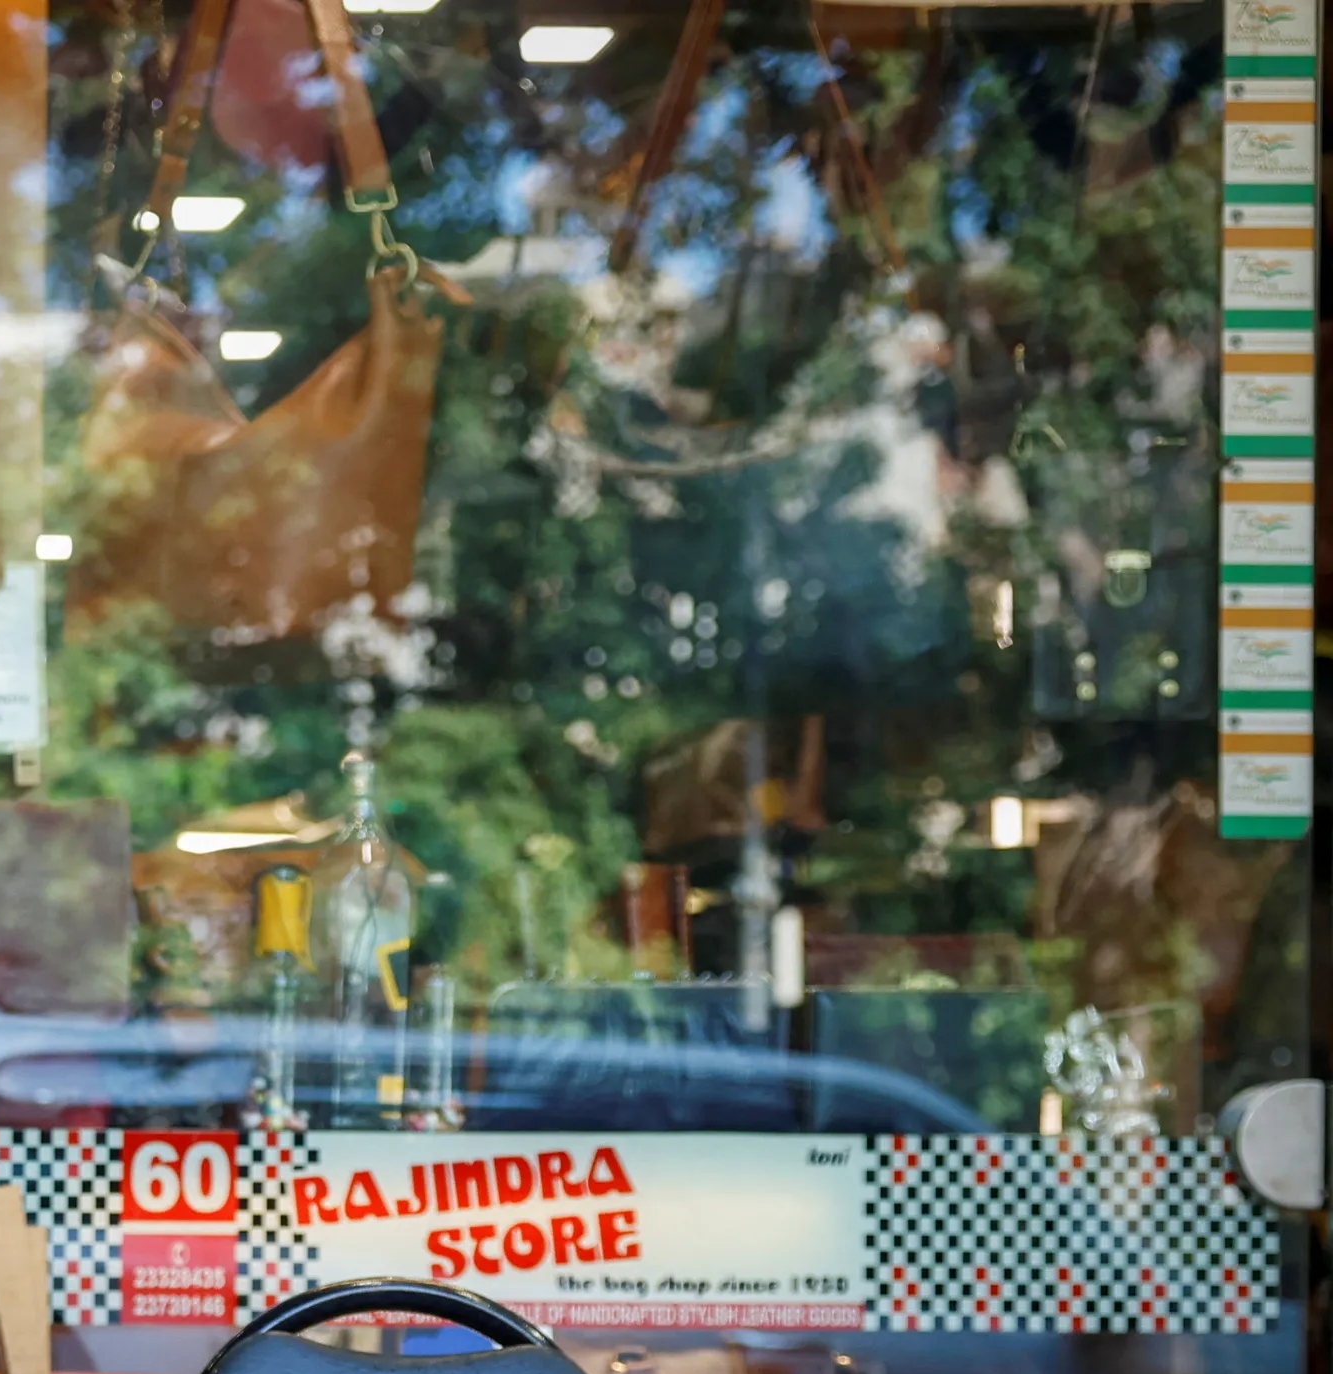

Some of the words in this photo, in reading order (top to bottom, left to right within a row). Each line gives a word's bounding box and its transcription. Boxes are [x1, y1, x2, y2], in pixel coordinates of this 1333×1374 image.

[130, 1140, 231, 1214] 60
[292, 1146, 633, 1226] RAJINDRA
[426, 1209, 643, 1279] STORE
[558, 1274, 592, 1291] the
[657, 1274, 710, 1295] shop
[718, 1274, 779, 1293] since
